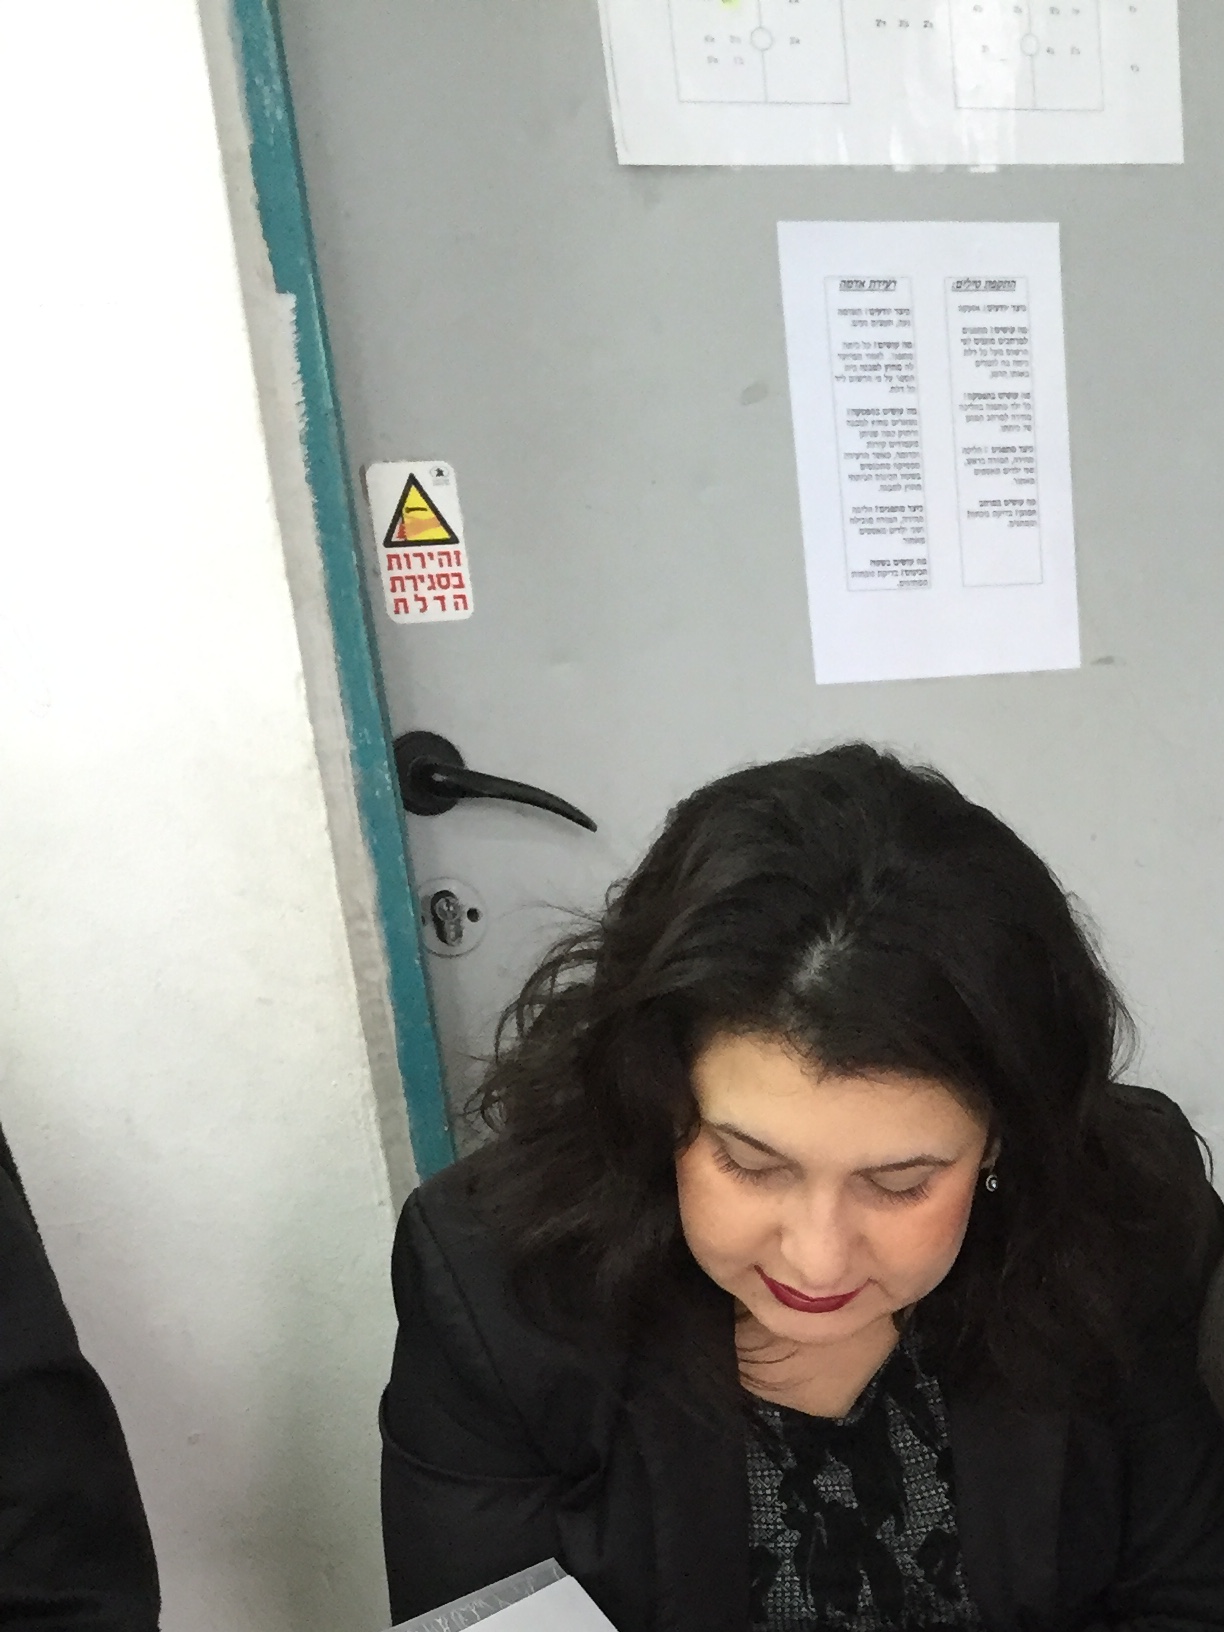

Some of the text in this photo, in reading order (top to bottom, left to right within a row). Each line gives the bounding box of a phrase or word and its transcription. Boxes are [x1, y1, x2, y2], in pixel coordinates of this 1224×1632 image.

[386, 550, 462, 571] זהירות
[390, 572, 466, 593] בסגירת
[393, 594, 469, 615] הדלת
